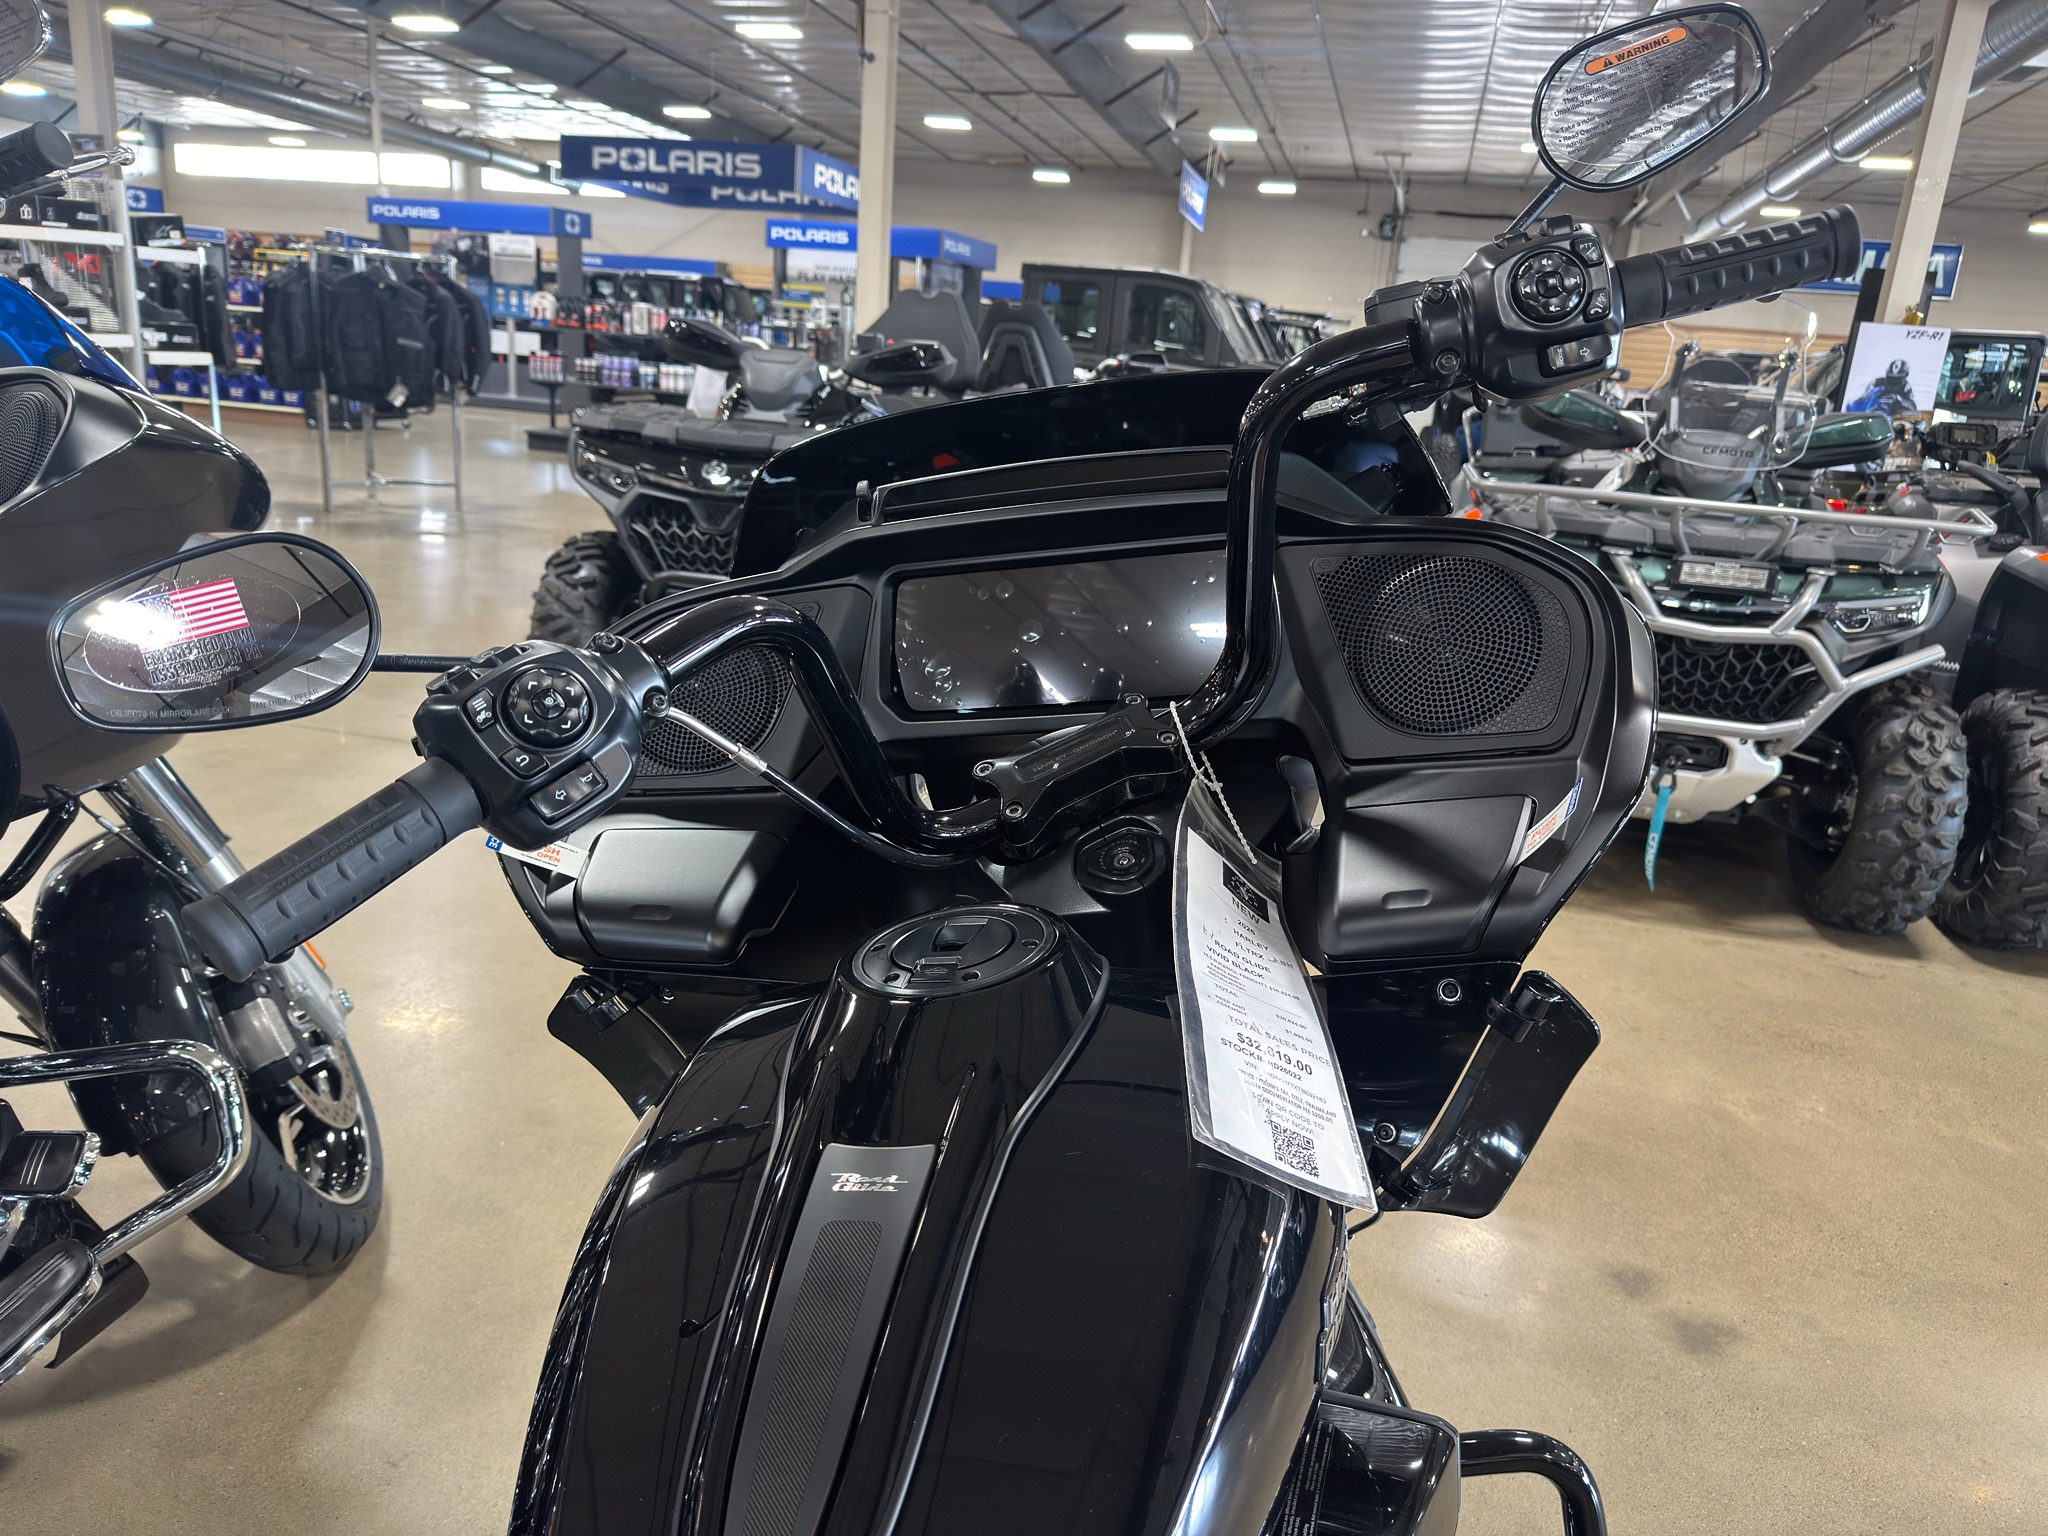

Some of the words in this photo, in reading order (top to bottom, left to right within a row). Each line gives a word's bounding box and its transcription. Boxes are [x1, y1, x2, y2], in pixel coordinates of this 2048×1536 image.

[1614, 36, 1671, 62] WARNING
[1563, 95, 1579, 105] They
[1580, 85, 1608, 99] operate,
[1565, 75, 1607, 95] Motorcycles
[1553, 101, 1585, 117] Unskilled
[1593, 87, 1625, 104] improper
[1609, 93, 1629, 105] death
[1666, 99, 1685, 110] Never
[1685, 94, 1697, 102] tow
[1703, 84, 1724, 96] trailer.
[1560, 123, 1576, 133] Take
[1580, 115, 1596, 125] rider
[1596, 107, 1620, 120] training
[1562, 131, 1579, 142] Read
[1579, 122, 1605, 136] Owner's
[1585, 130, 1606, 142] adding
[1626, 128, 1654, 141] removed
[1654, 124, 1662, 132] by
[592, 146, 763, 179] POLARIS
[814, 162, 860, 201] POLA
[372, 204, 440, 220] POLARIS
[770, 226, 849, 244] POLARIS
[1579, 242, 1593, 250] PTT
[1905, 328, 1945, 341] YZF-R1
[1702, 446, 1754, 459] CFMOTO
[142, 636, 220, 669] ENGINEERED
[220, 631, 237, 649] IN
[237, 627, 257, 645] WI
[149, 652, 225, 685] ASSEMBLED
[226, 648, 242, 666] IN
[242, 643, 263, 661] PA
[110, 709, 149, 719] OBJECTS
[149, 710, 158, 718] IN
[160, 709, 192, 718] MIRROR
[193, 708, 211, 716] ARE
[268, 697, 287, 707] THEY
[289, 688, 320, 703] APPEAR
[1033, 729, 1117, 773] HARLEY-DAVIDSON
[537, 851, 561, 863] OPEN
[1232, 896, 1260, 925] NEW
[1233, 928, 1269, 951] HARLEY
[1206, 944, 1230, 963] VIVID
[1231, 960, 1265, 980] BLACK
[1214, 940, 1240, 959] ROAD
[1242, 956, 1271, 974] GLIDE
[1214, 983, 1239, 998] TOTAL
[1228, 1014, 1263, 1036] TOTAL
[1264, 1031, 1298, 1051] SALES
[1301, 1047, 1332, 1068] PRICE
[1237, 1032, 1313, 1076] $32,819.00
[1267, 1060, 1303, 1082] HD26022
[1262, 1086, 1302, 1110] DOCUMENTATION
[1251, 1092, 1274, 1107] SCAN
[1275, 1103, 1288, 1113] QR
[1288, 1110, 1312, 1125] CODE
[1313, 1121, 1325, 1131] TO
[1265, 1108, 1290, 1124] APPLY
[831, 1173, 908, 1184] Road
[832, 1182, 899, 1192] Glide
